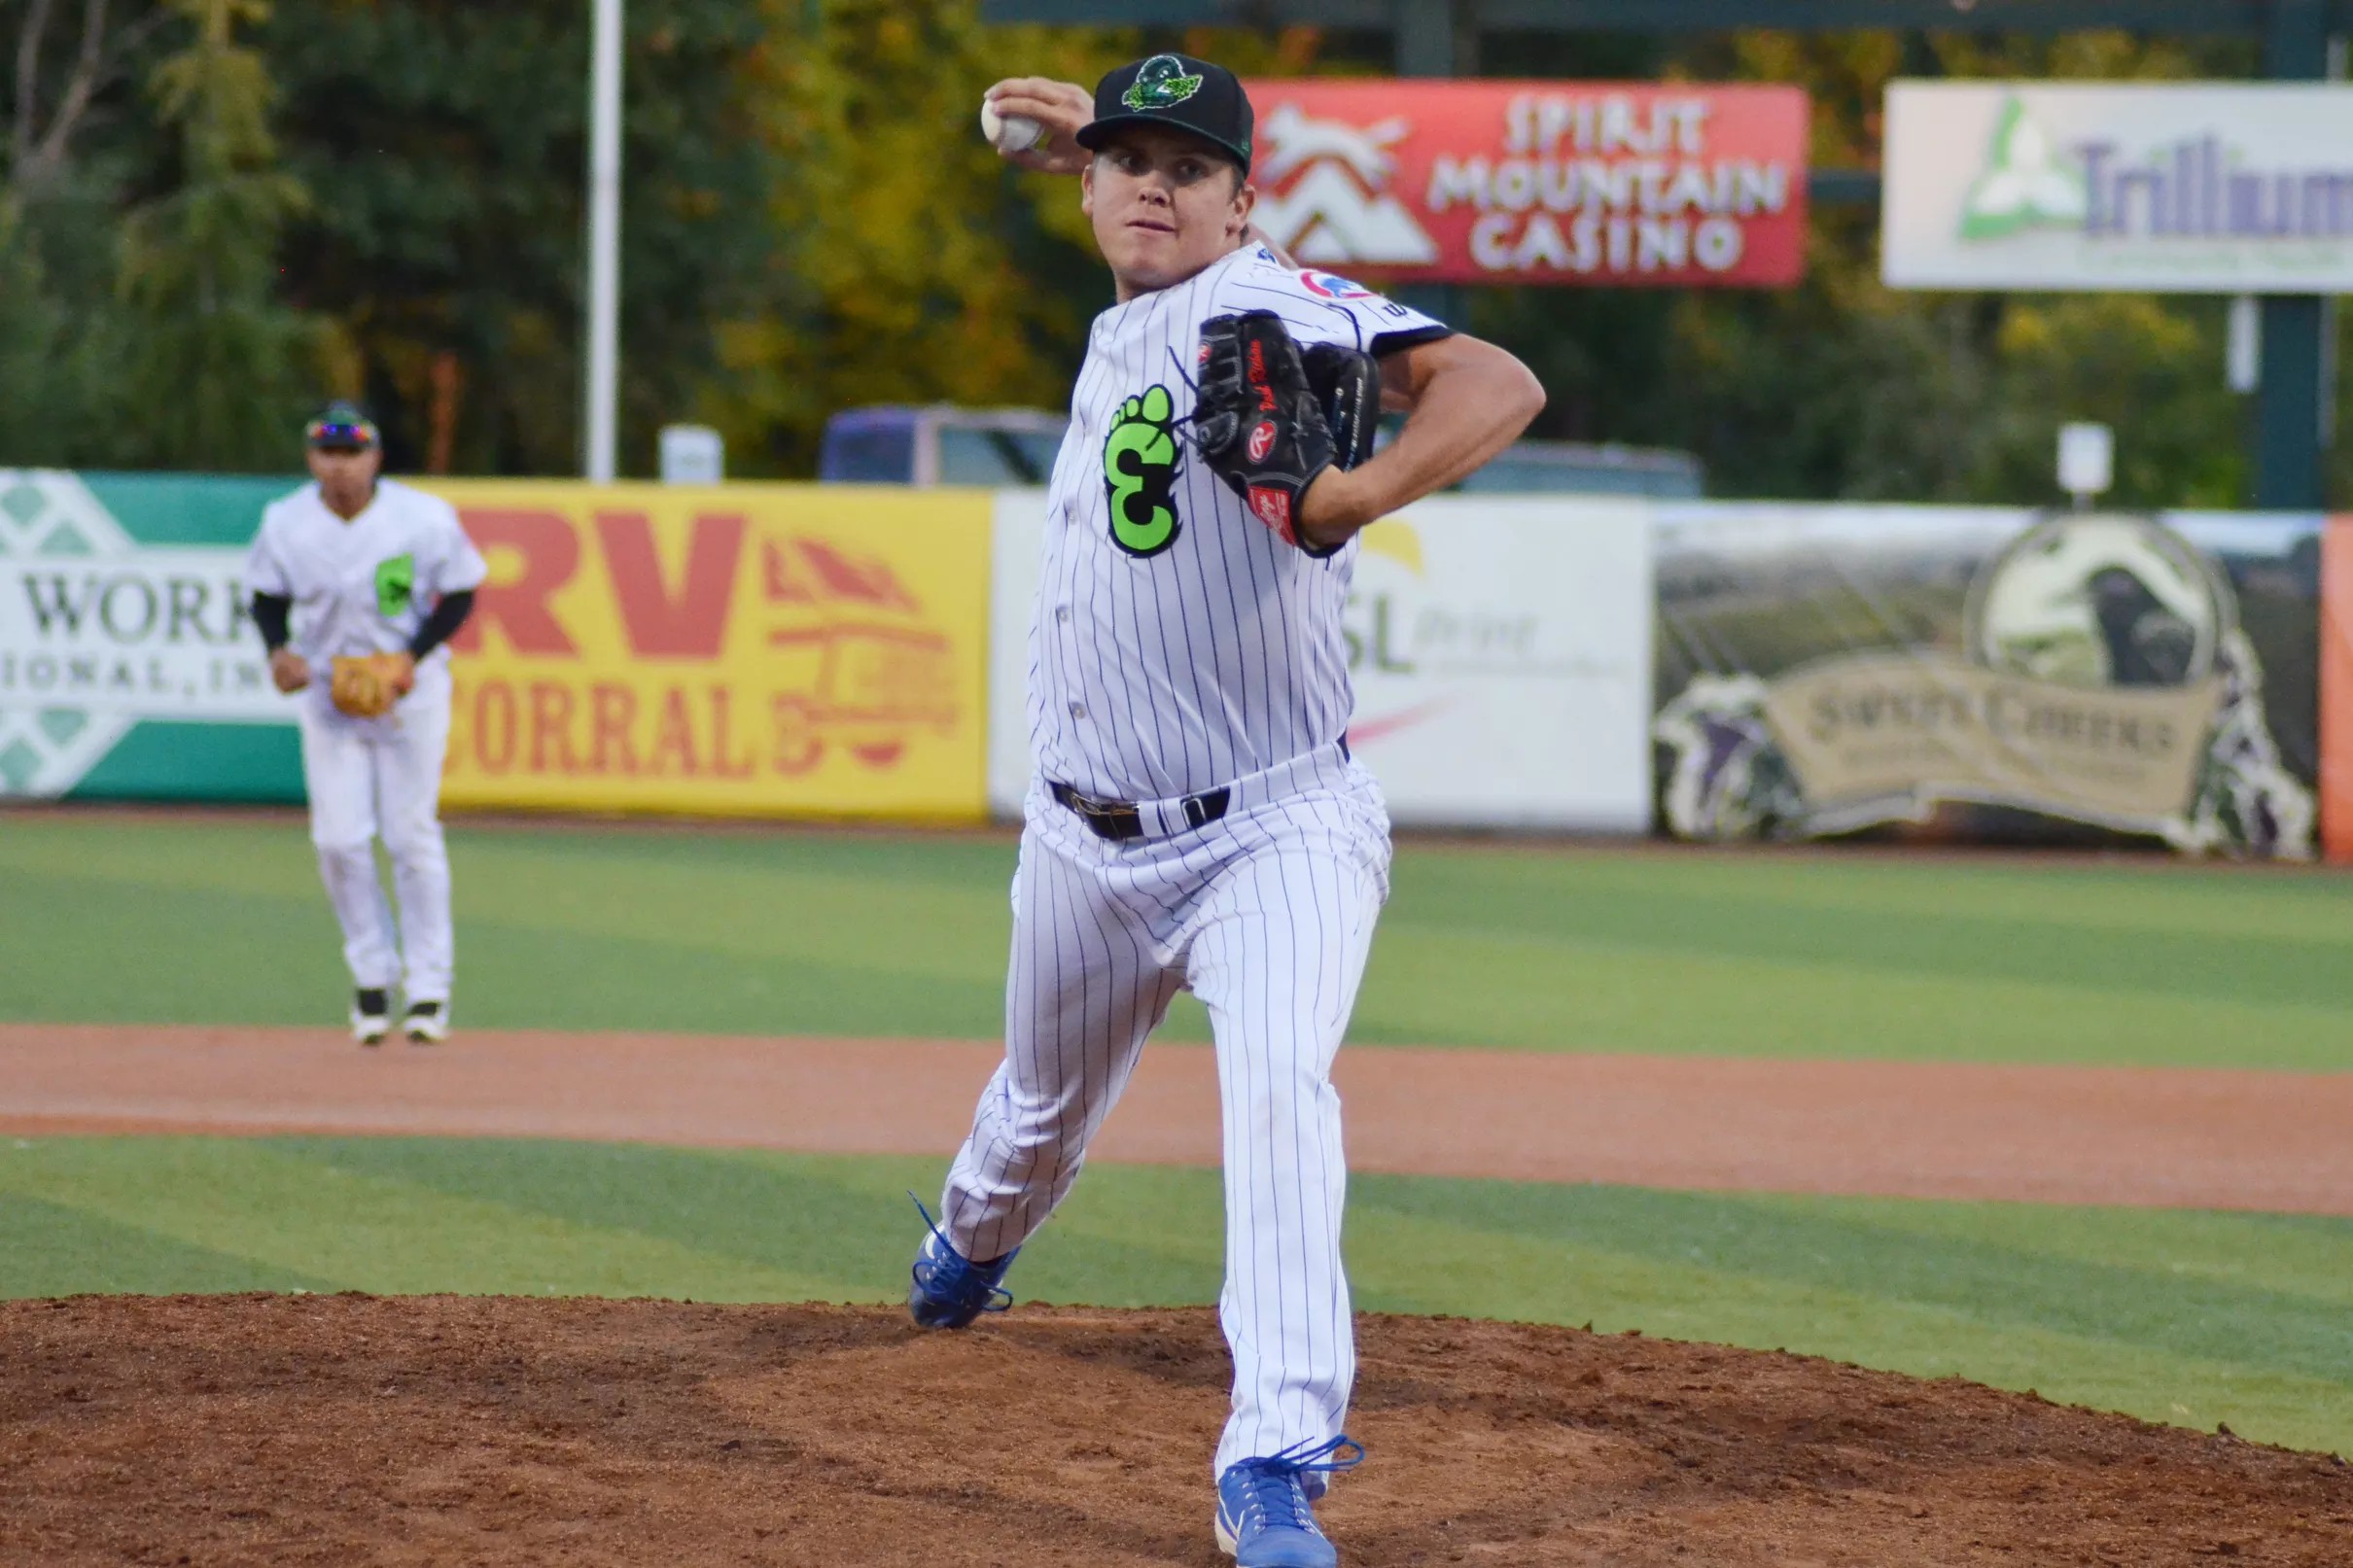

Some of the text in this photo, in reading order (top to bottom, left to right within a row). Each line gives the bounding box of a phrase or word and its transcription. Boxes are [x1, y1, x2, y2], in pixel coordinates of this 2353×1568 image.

[1503, 94, 1710, 154] SPIRIT
[1426, 156, 1789, 214] MOUNTAIN
[1469, 211, 1744, 272] CASINO
[449, 506, 748, 659] RV
